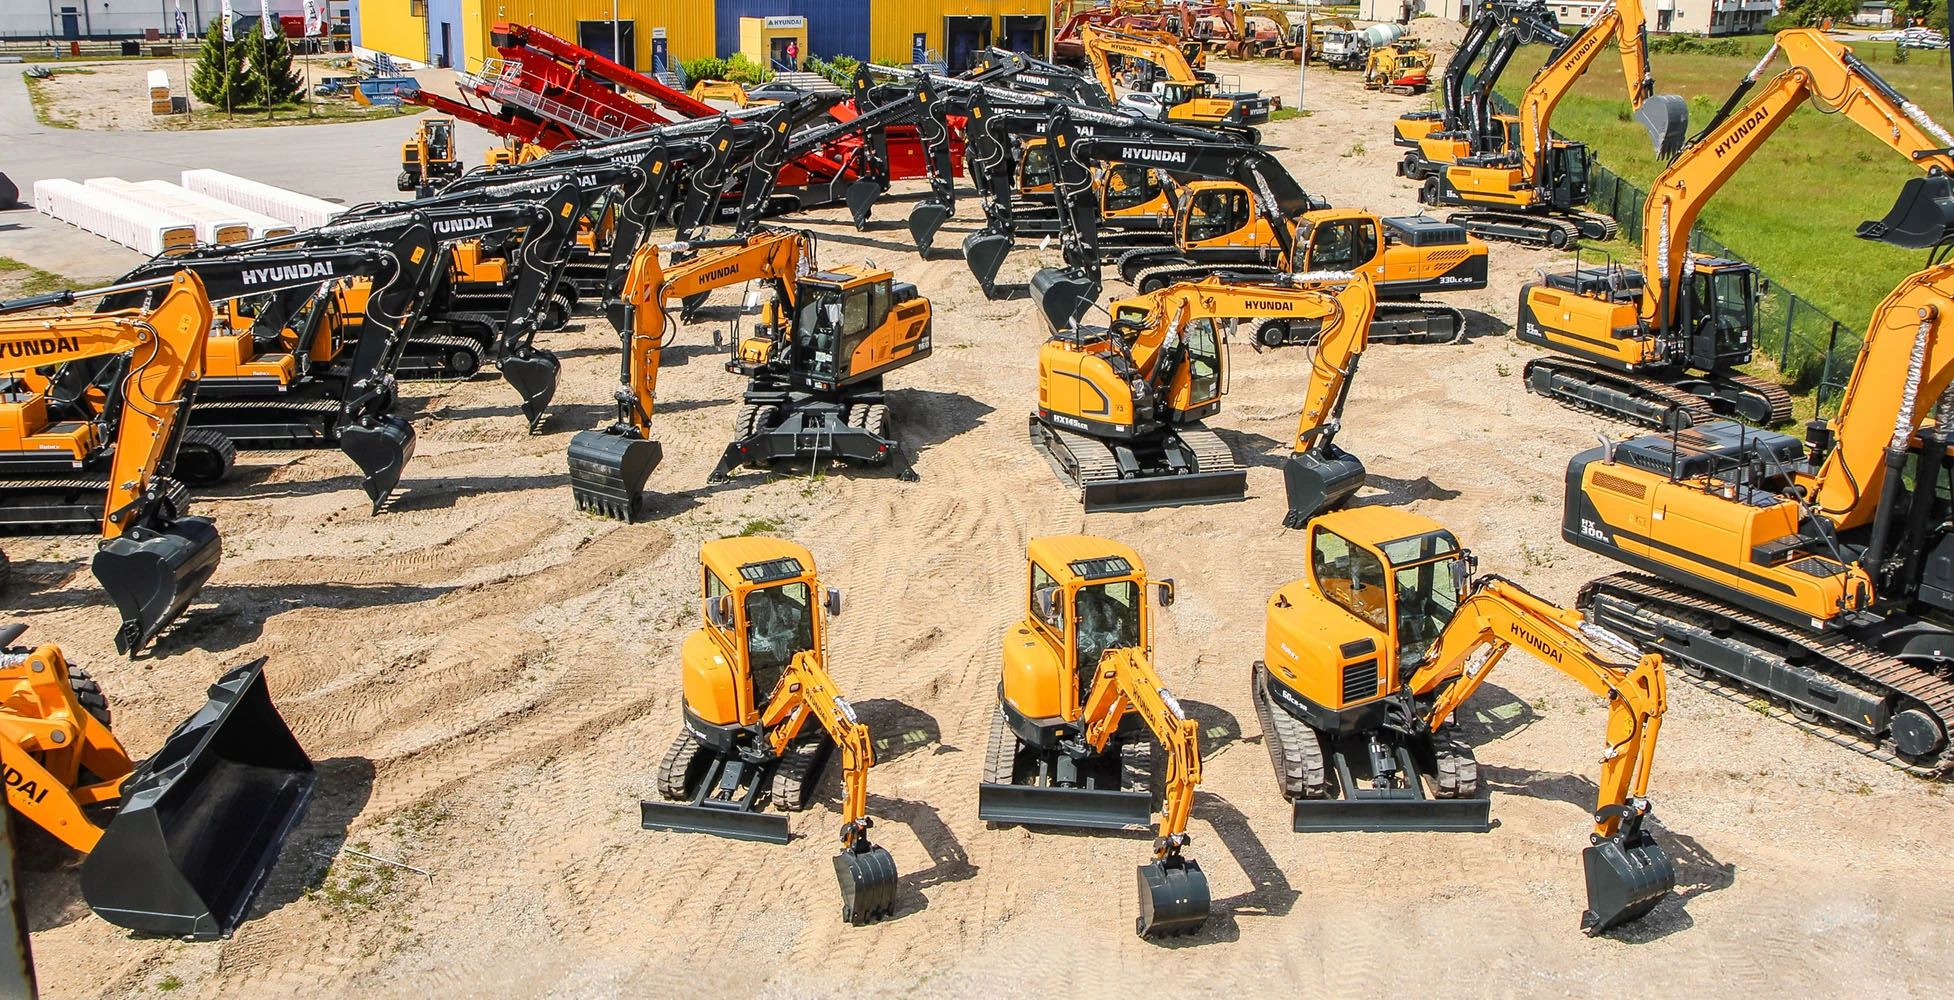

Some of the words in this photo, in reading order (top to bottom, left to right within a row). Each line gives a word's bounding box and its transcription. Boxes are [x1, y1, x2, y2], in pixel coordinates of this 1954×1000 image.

[1111, 44, 1137, 52] HYUNDAI
[1564, 35, 1598, 71] HYUNDAI
[1016, 74, 1049, 86] HYUNDAI
[1714, 106, 1769, 158] HYUNDAI
[1122, 147, 1186, 163] HYUNDAI
[721, 206, 740, 215] 694
[432, 215, 493, 234] YUNDAI
[241, 261, 334, 285] HYUNDAI
[698, 263, 739, 285] HYUNDAI
[1245, 300, 1293, 311] HYUNDAI
[0, 336, 81, 359] YUNDAI
[1581, 518, 1596, 529] HX
[1510, 622, 1563, 663] HYUNDAI
[805, 687, 829, 723] HYUNDAI
[1132, 686, 1156, 726] HYUNDAI
[3, 763, 49, 804] DAI
